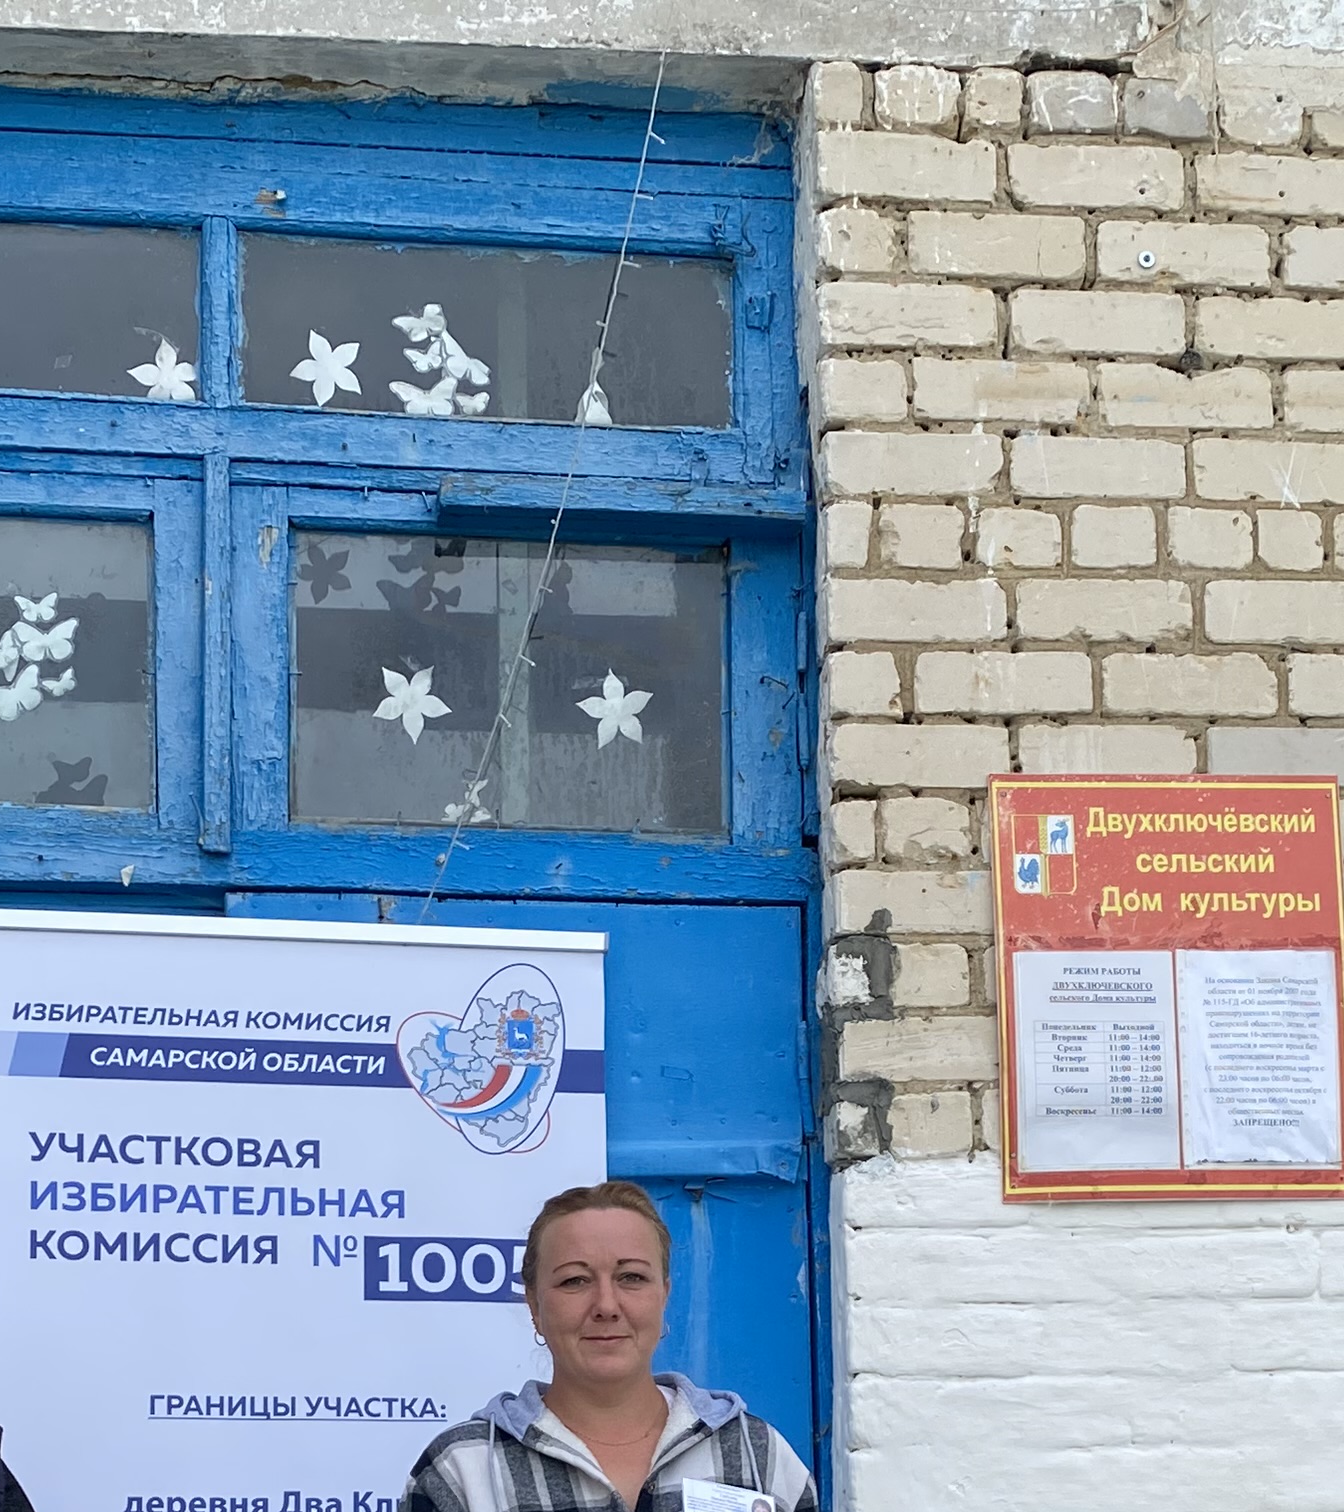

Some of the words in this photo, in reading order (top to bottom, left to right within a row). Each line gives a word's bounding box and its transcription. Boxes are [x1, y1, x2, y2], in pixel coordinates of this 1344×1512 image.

[1086, 806, 1316, 838] Двухключёвский
[1135, 846, 1275, 873] сельский
[1100, 886, 1163, 918] Дом
[1180, 891, 1321, 919] культуры
[1063, 967, 1099, 975] РЕЖИМ
[1101, 967, 1141, 976] РАБОТЫ
[11, 1001, 239, 1030] ИЗБИРАТЕЛЬНАЯ
[245, 1010, 392, 1034] КОМИССИЯ
[90, 1046, 257, 1072] САМАРСКОЙ
[262, 1052, 386, 1076] ОБЛАСТИ
[28, 1131, 321, 1169] УЧАСТКОВАЯ
[28, 1181, 407, 1219] ИЗБИРАТЕЛЬНАЯ
[28, 1229, 279, 1266] КОМИССИЯ
[313, 1234, 358, 1267] №
[148, 1394, 297, 1420] ГРАНИЦЫ
[304, 1396, 448, 1420] УЧАСТКА:
